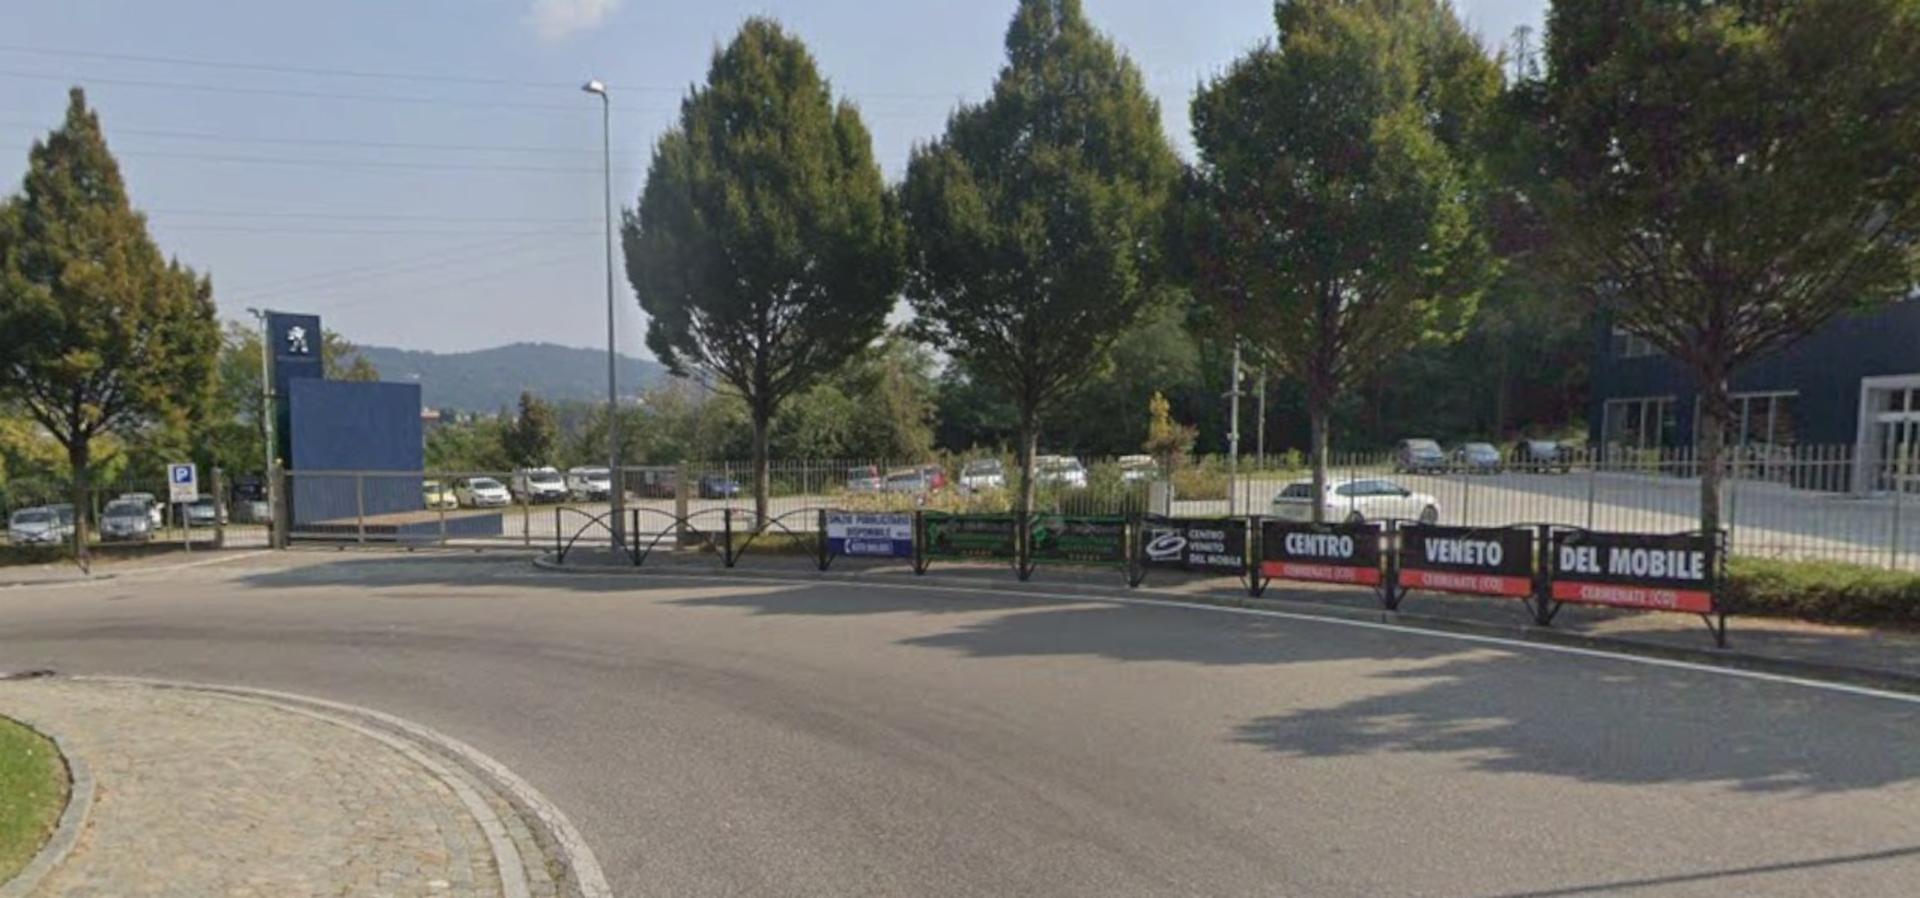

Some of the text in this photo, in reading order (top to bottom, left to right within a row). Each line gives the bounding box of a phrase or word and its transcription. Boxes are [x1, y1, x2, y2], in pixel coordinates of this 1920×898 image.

[176, 468, 188, 481] P
[1188, 529, 1225, 540] CENTRO
[1189, 542, 1225, 552] VENETO
[1285, 532, 1354, 558] CENTRO
[1425, 538, 1503, 566] VENETO
[1189, 553, 1242, 567] DEL MOBILE
[1559, 546, 1706, 580] DEL MOBILE
